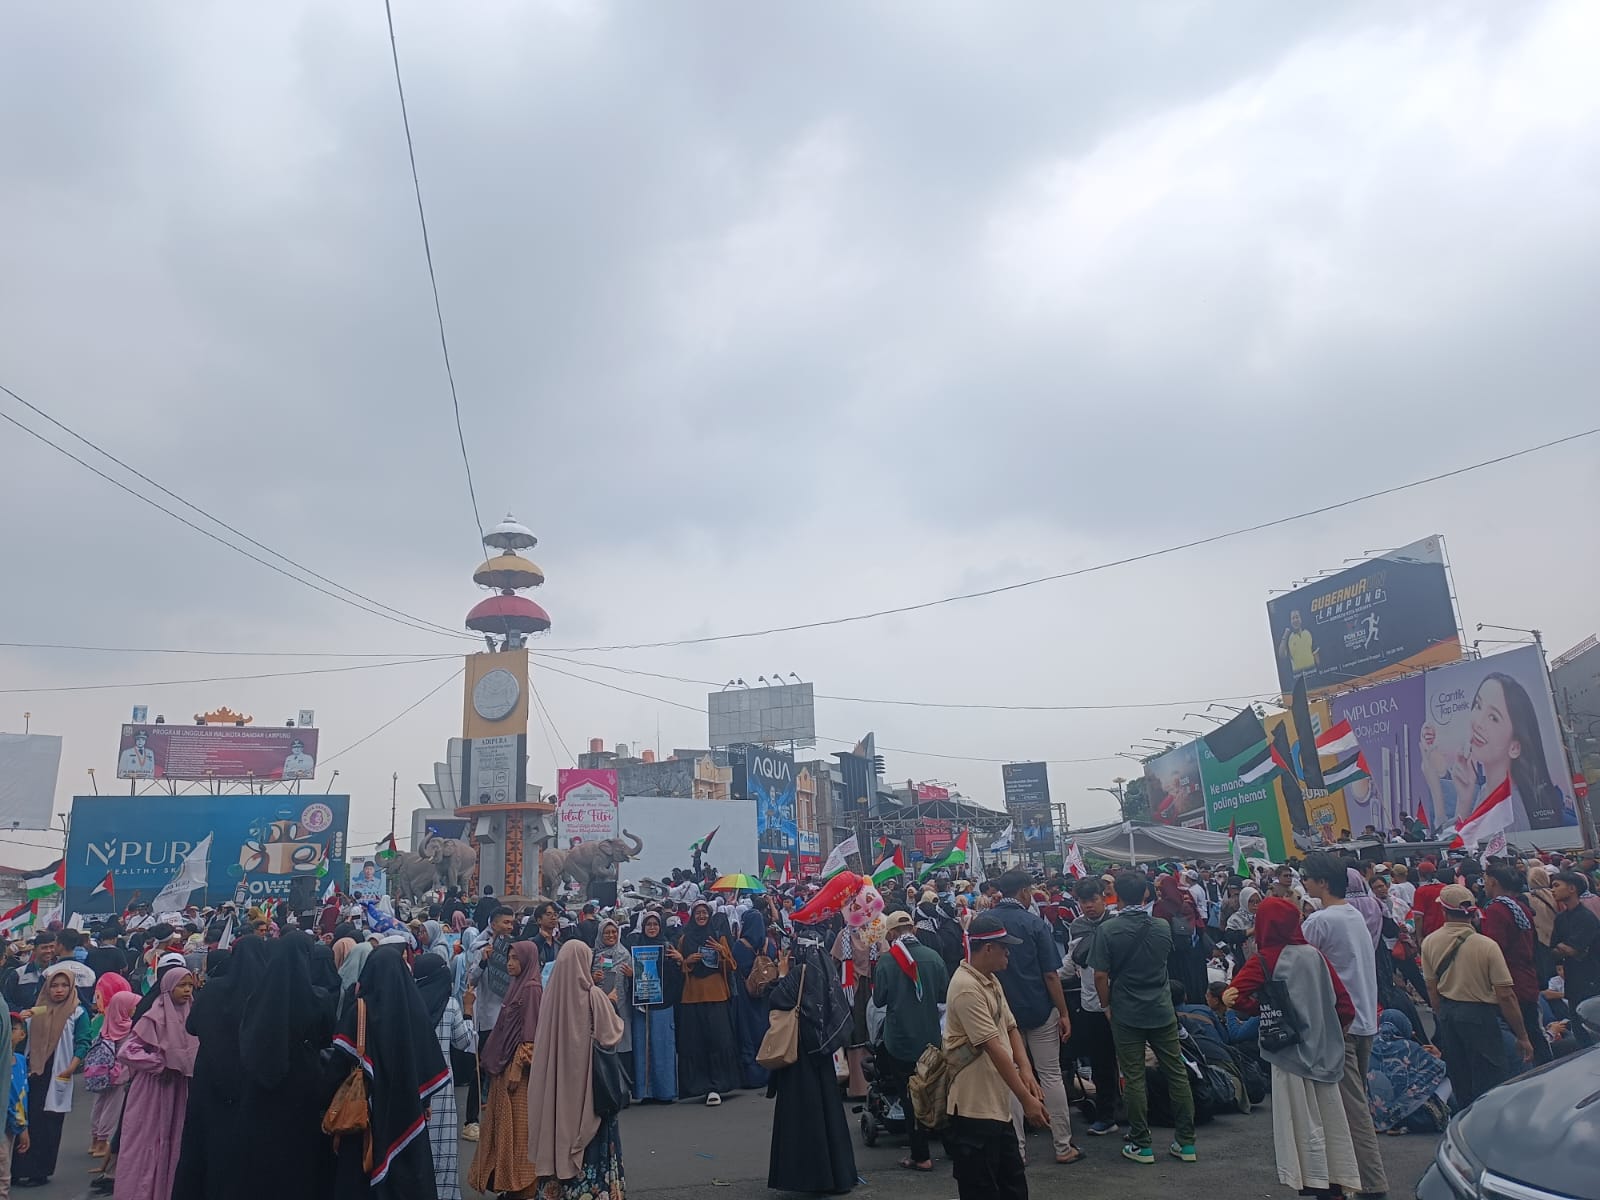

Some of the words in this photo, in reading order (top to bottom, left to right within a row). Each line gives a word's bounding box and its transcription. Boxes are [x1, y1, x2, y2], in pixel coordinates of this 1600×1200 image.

[1319, 588, 1382, 620] LAMPUNG
[1343, 697, 1399, 722] IMPLORA
[752, 756, 791, 782] AQUA
[1210, 783, 1221, 795] Ke
[1213, 796, 1239, 814] paling
[1239, 788, 1268, 804] hemat
